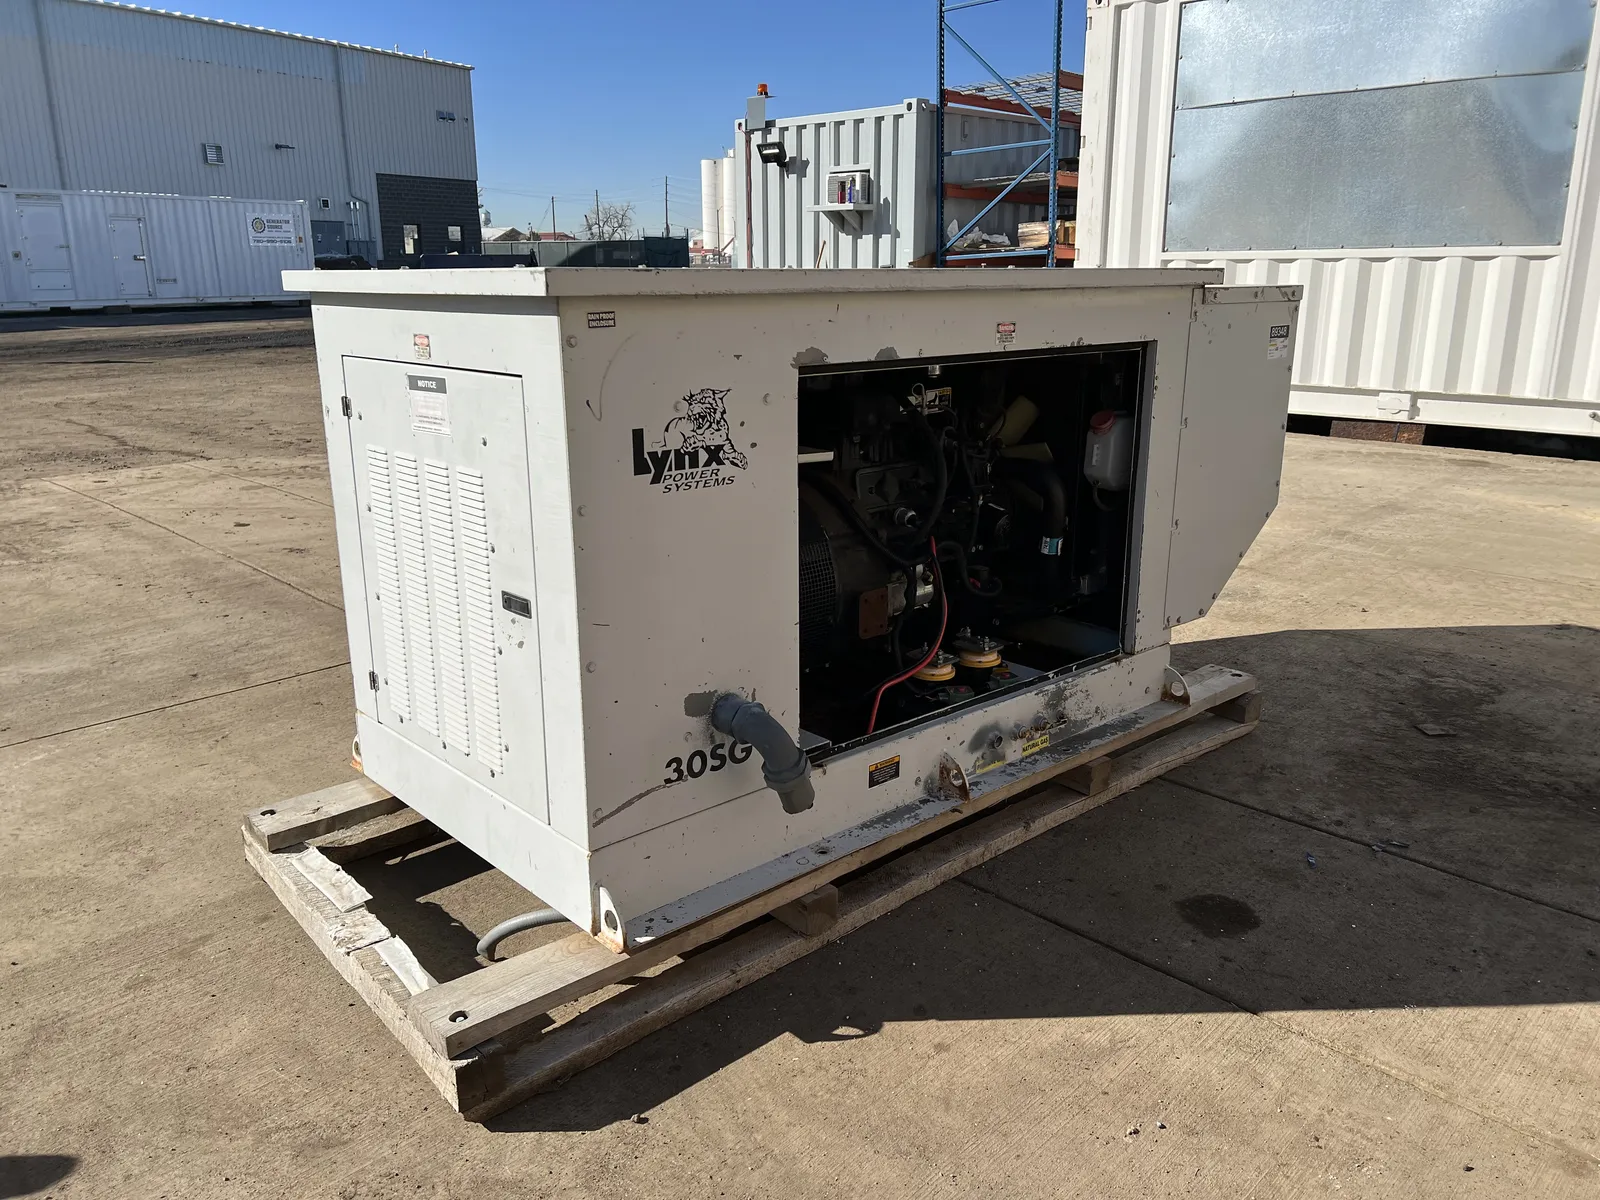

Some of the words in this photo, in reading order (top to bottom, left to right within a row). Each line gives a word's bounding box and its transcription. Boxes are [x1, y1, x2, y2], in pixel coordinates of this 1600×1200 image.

[417, 380, 437, 389] NOTICE
[632, 428, 726, 485] Lynx
[662, 468, 721, 484] POWER
[662, 475, 736, 494] SYSTEMS
[1022, 740, 1040, 753] NATURAL
[1040, 736, 1049, 745] GAS
[663, 740, 753, 785] 30SG
